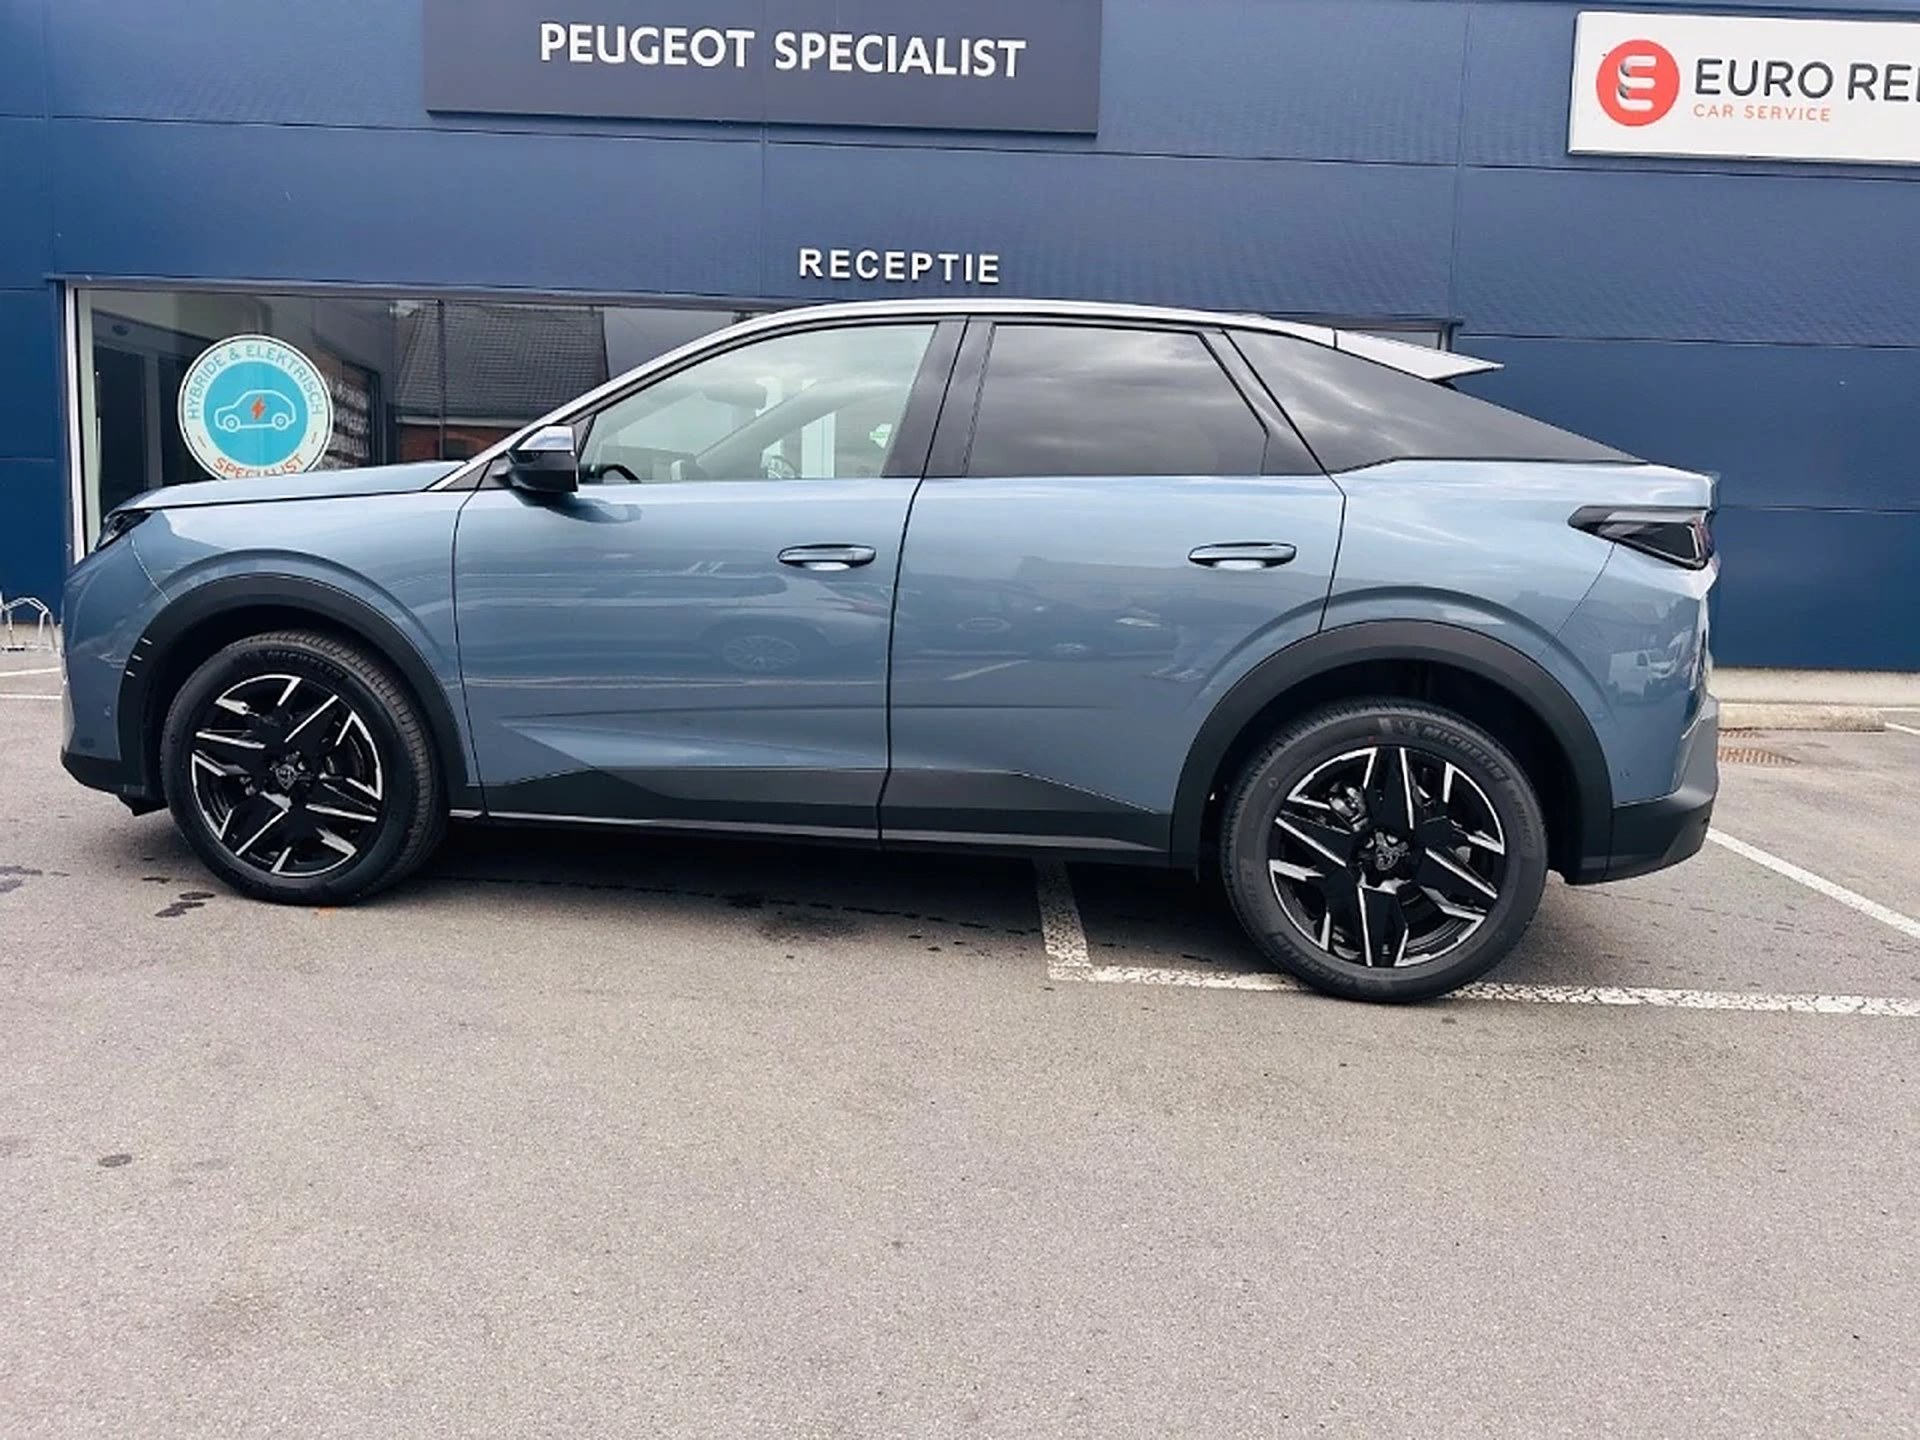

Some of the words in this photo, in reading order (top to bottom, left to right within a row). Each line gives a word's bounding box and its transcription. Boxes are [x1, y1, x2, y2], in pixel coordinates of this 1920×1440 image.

[540, 22, 755, 68] PEUGEOT
[774, 31, 1027, 78] SPECIALIST
[1694, 57, 1834, 99] EURO
[1847, 63, 1920, 103] RE
[1693, 102, 1735, 118] CAR
[1743, 104, 1832, 122] SERVICE
[799, 248, 1000, 284] RECEPTIE
[186, 353, 227, 420] HYBRIDE
[229, 347, 242, 361] &
[245, 343, 324, 416] ELEKTRISCH
[1421, 725, 1508, 782] MICHELIN
